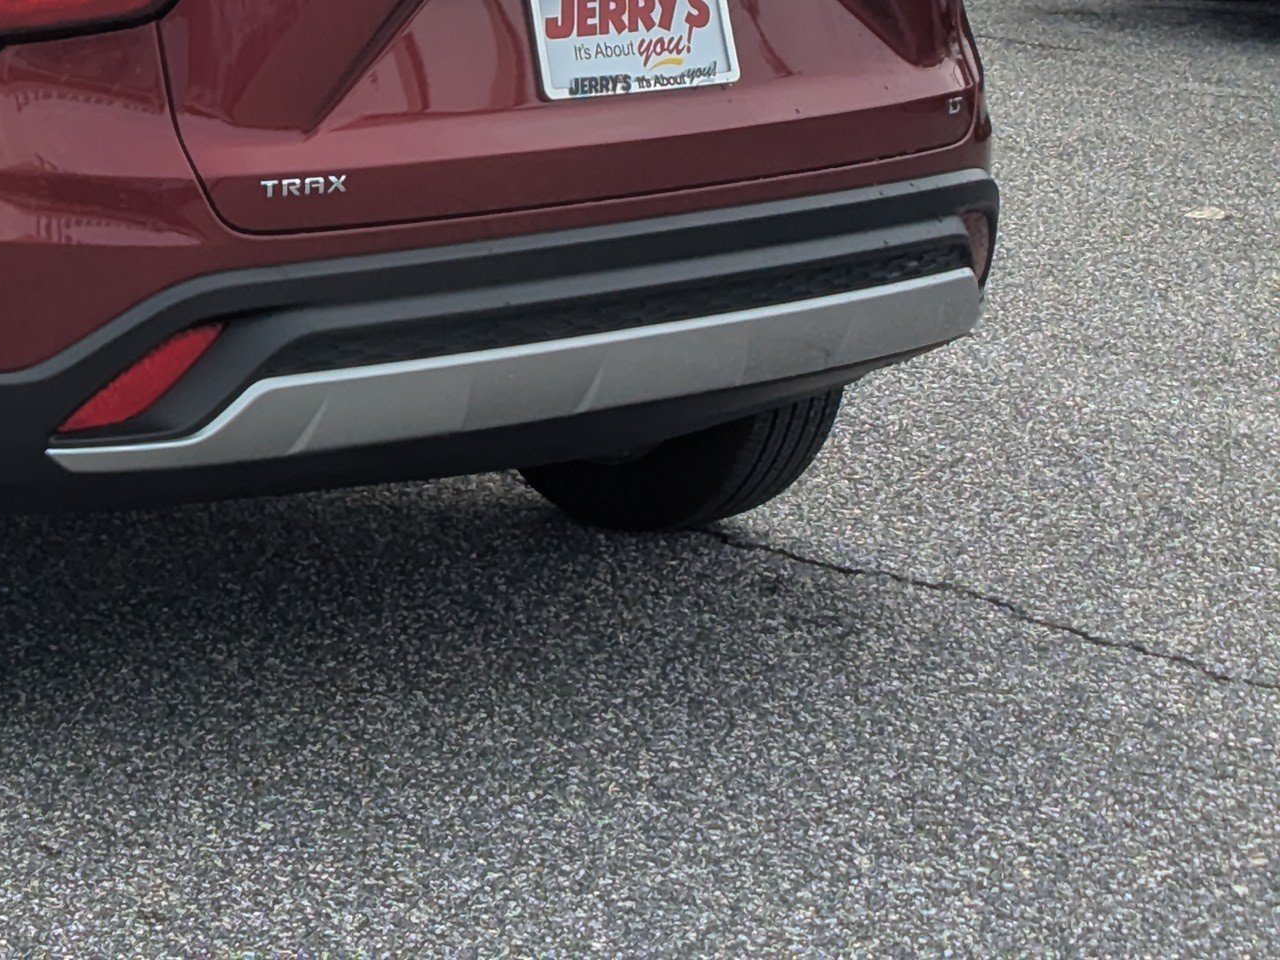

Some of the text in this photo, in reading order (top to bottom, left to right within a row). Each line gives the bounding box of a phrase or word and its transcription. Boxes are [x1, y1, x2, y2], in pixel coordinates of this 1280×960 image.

[573, 25, 694, 67] It's About you!
[568, 60, 717, 96] JERRY'S It's About you!
[260, 174, 347, 198] TRAX
